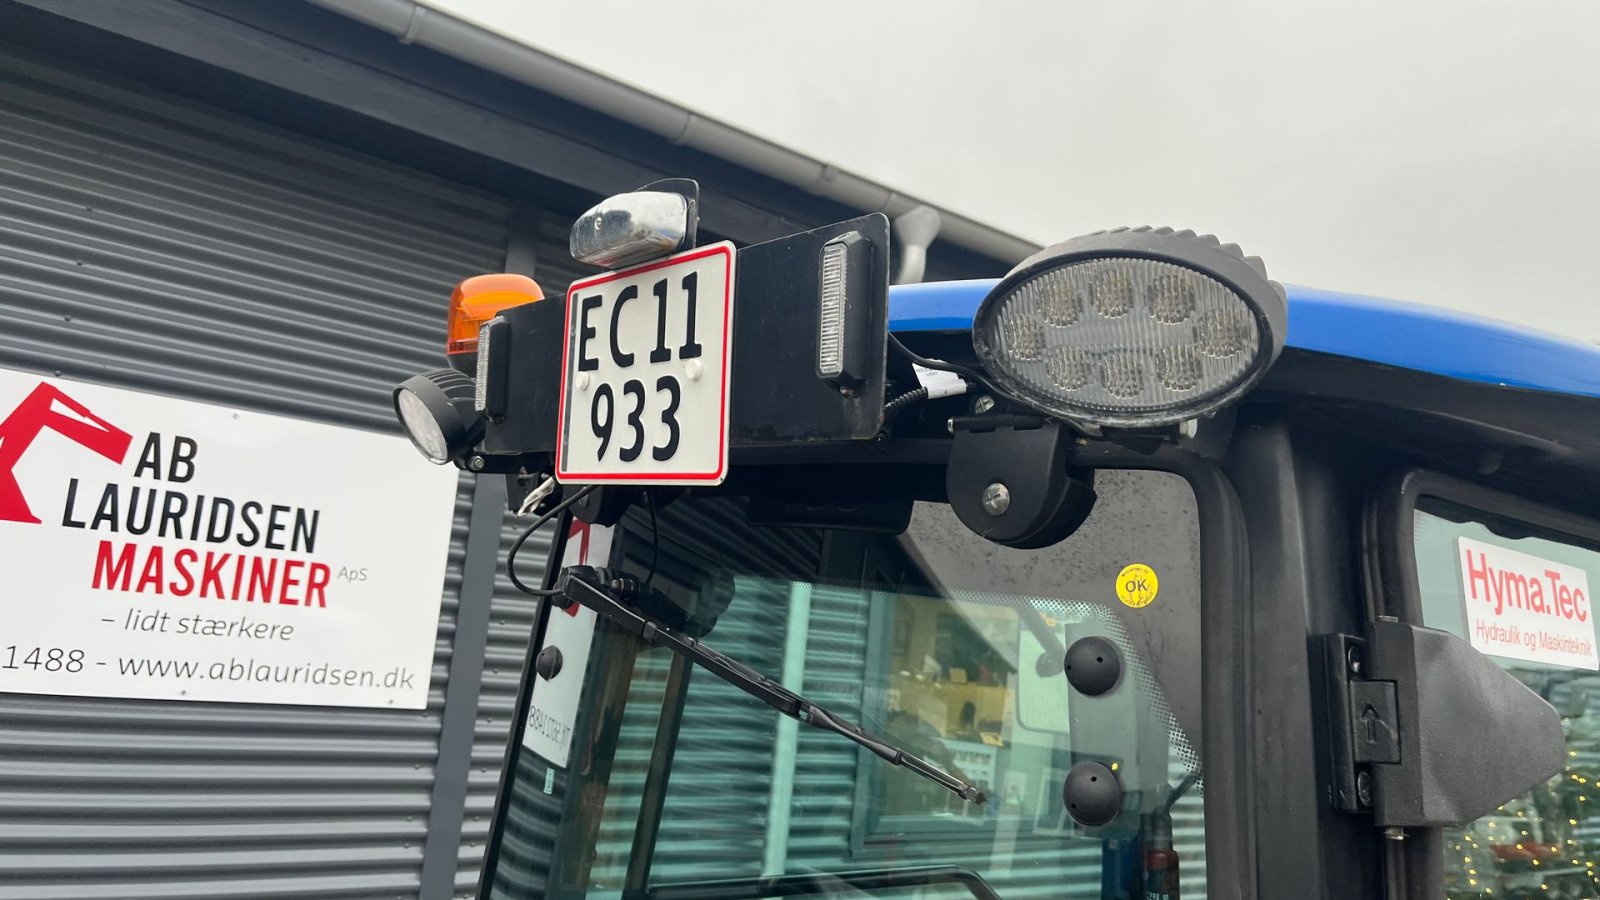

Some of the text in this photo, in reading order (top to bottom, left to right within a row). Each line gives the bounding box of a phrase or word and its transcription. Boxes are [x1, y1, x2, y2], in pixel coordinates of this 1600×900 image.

[591, 375, 681, 463] 933
[133, 431, 198, 484] AB
[61, 477, 320, 554] LAURIDSEN
[91, 539, 331, 608] MASKINER
[337, 566, 367, 582] ApS
[1125, 579, 1148, 593] OK
[1466, 549, 1590, 622] Hyma.Tec
[124, 607, 171, 633] lidt
[175, 614, 294, 641] stærkere
[1476, 619, 1593, 656] Hydraulik og Maskinteknik
[1, 645, 85, 674] 1488
[118, 657, 414, 689] www.ablauridsen.dk
